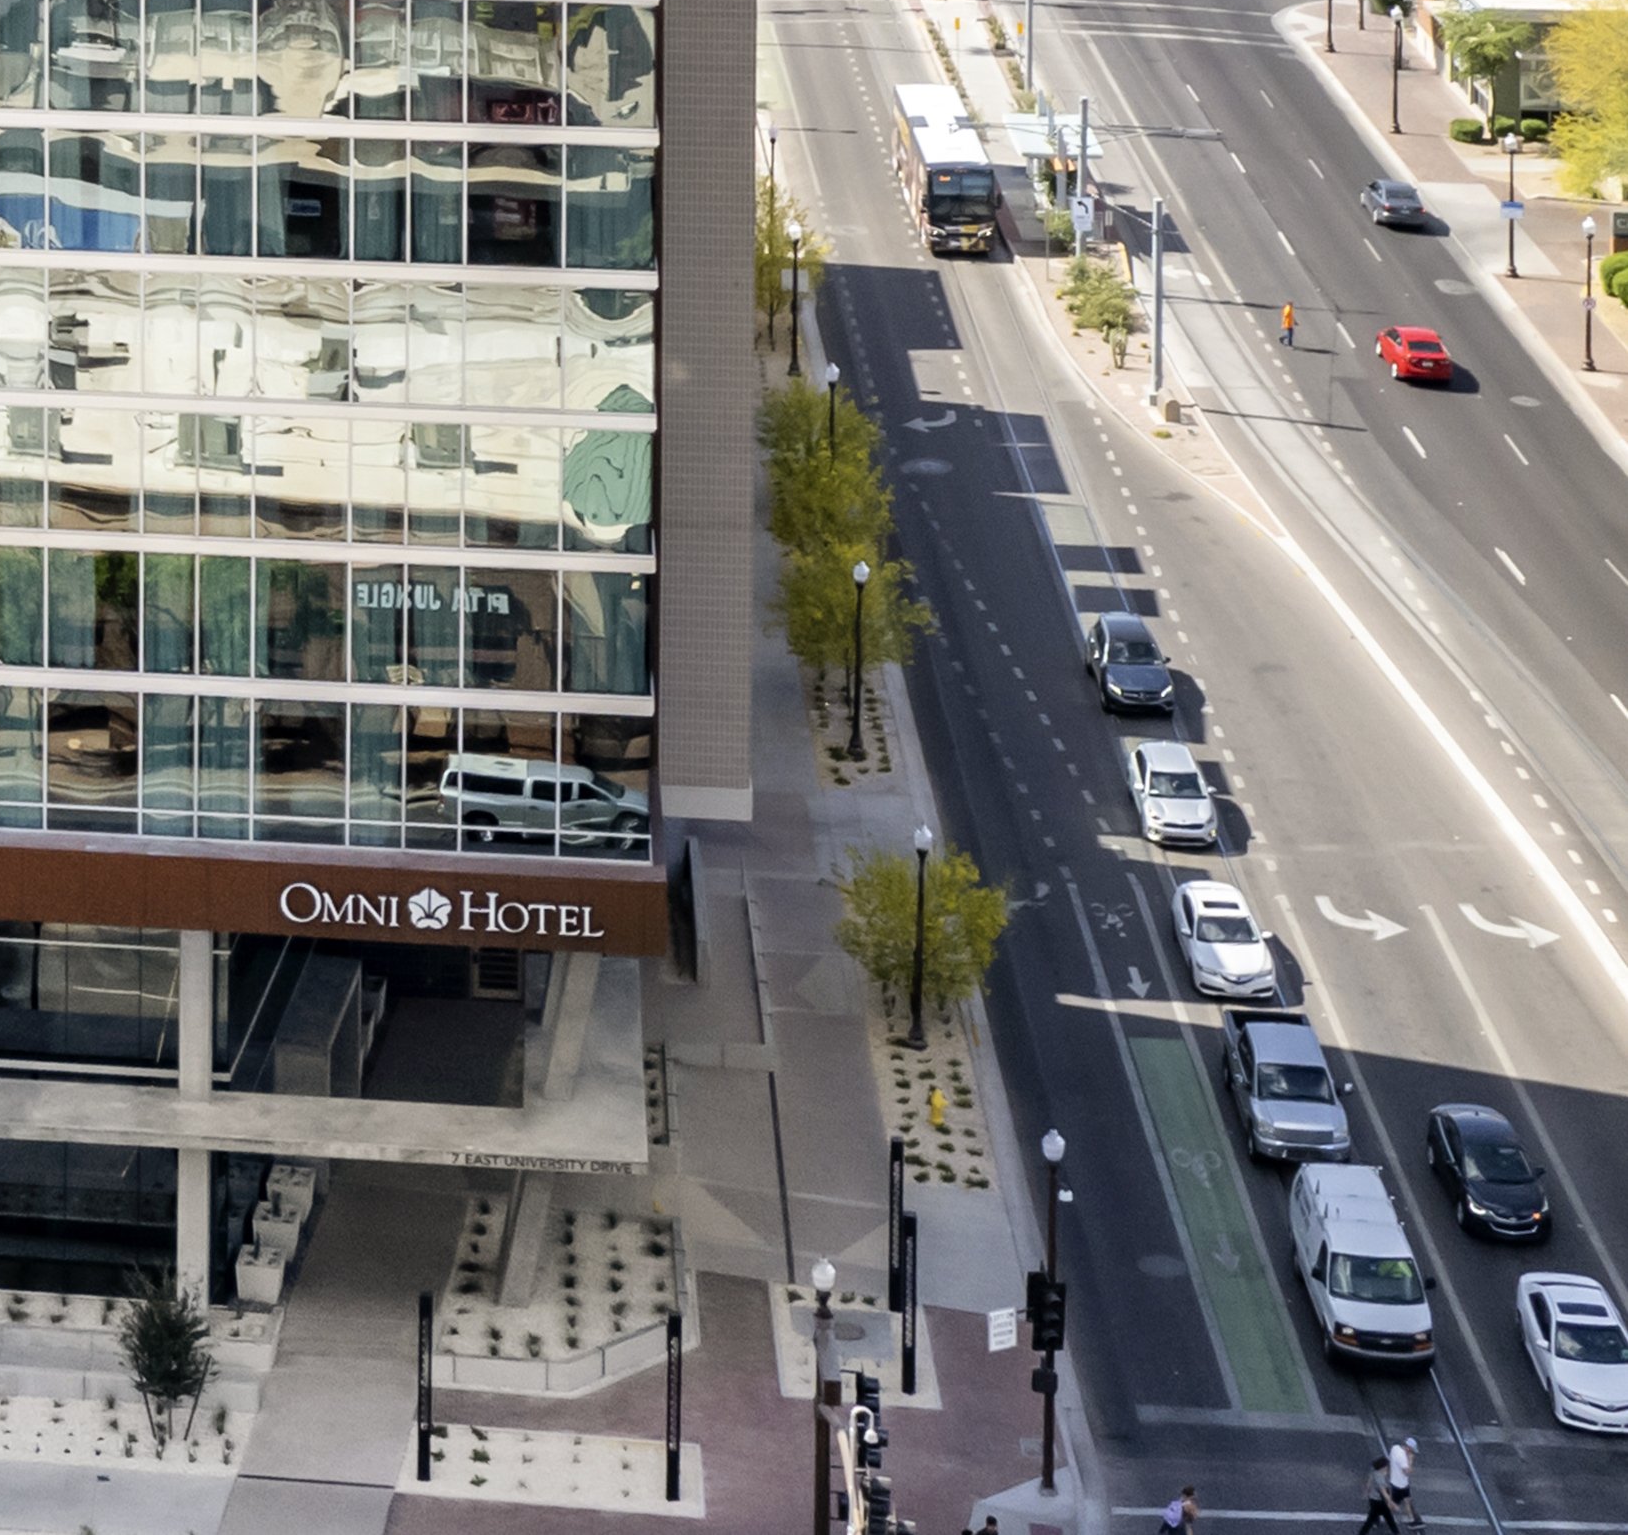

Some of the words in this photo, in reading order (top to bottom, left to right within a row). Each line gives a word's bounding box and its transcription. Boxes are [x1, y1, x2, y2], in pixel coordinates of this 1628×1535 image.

[280, 882, 399, 928] OMNI
[459, 891, 604, 937] HOTEL
[452, 1153, 459, 1165] 7
[465, 1153, 499, 1166] EAST
[504, 1155, 586, 1171] UNIVERSITY
[590, 1161, 633, 1174] DRIVE
